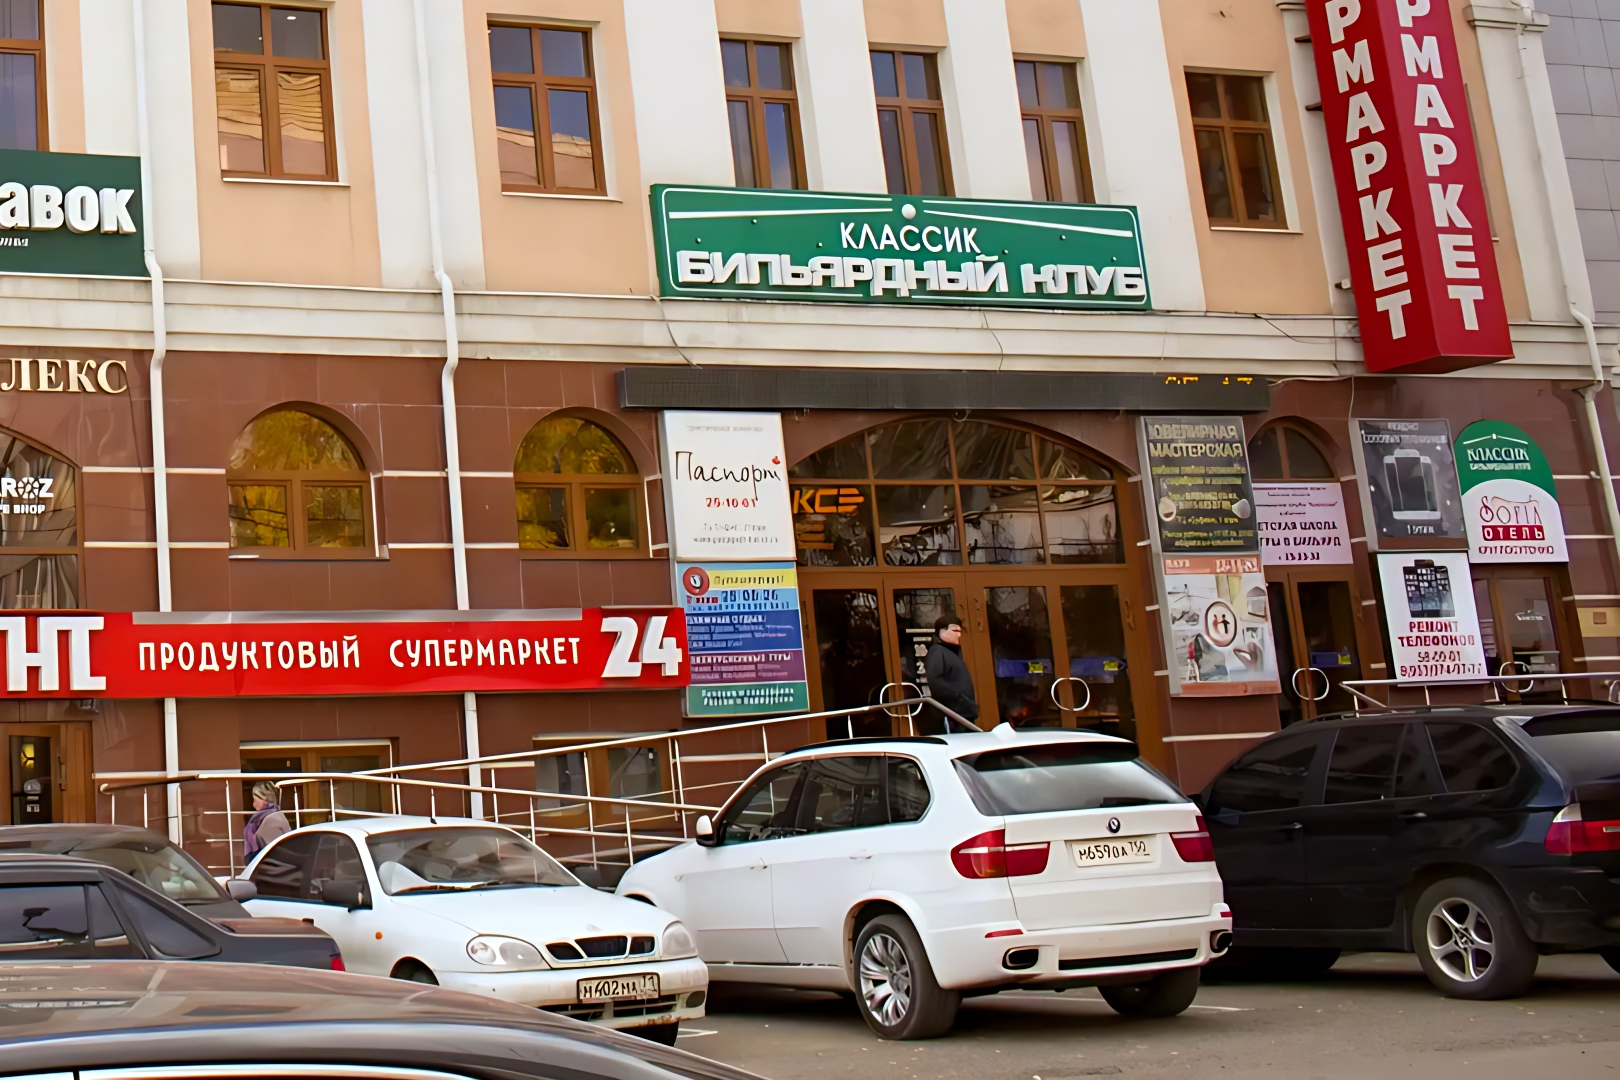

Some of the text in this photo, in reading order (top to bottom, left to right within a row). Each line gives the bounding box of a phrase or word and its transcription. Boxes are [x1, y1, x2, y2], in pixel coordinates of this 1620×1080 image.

[839, 221, 982, 254] КЛАССИК
[676, 249, 1146, 298] БИЛЬЯРДНЫЙ КЛУБ
[1483, 526, 1544, 540] ОТЕЛЬ
[138, 633, 581, 672] ПРОДУКТОВЫЙ СУПЕРМАРКЕТ
[599, 615, 683, 679] 24
